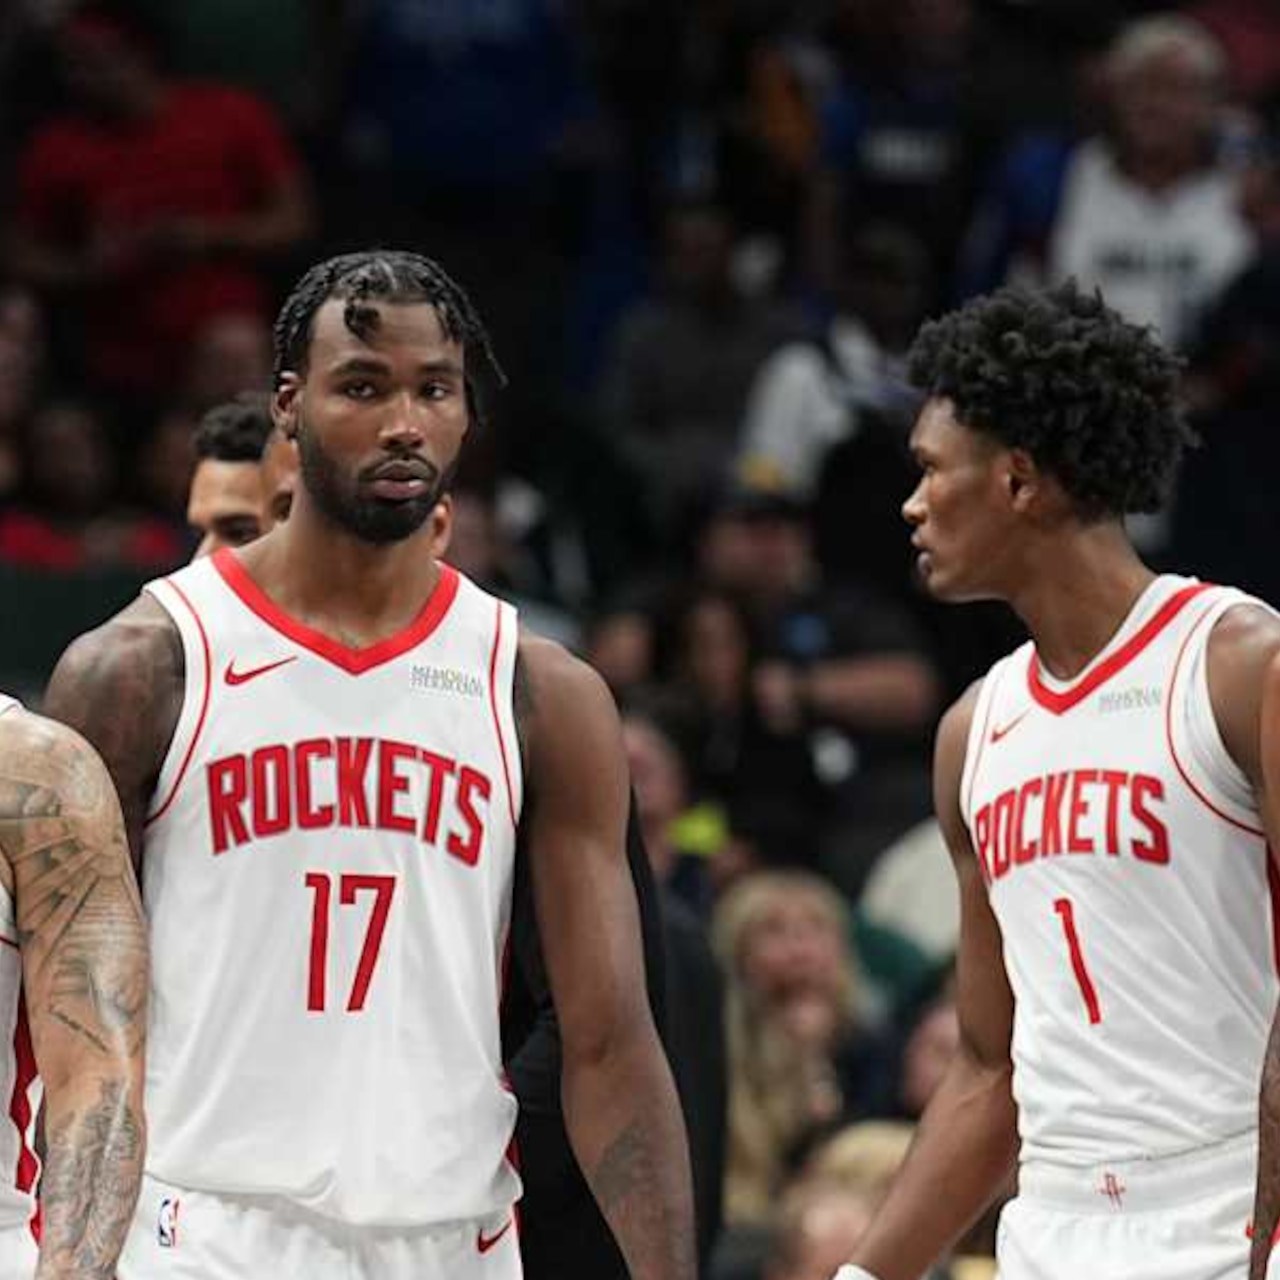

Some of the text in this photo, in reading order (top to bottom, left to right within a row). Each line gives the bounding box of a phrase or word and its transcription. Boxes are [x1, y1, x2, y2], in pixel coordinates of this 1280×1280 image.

[206, 736, 493, 868] ROCKETS
[975, 767, 1172, 885] ROCKETS
[305, 871, 397, 1013] 17
[1053, 896, 1103, 1025] 1
